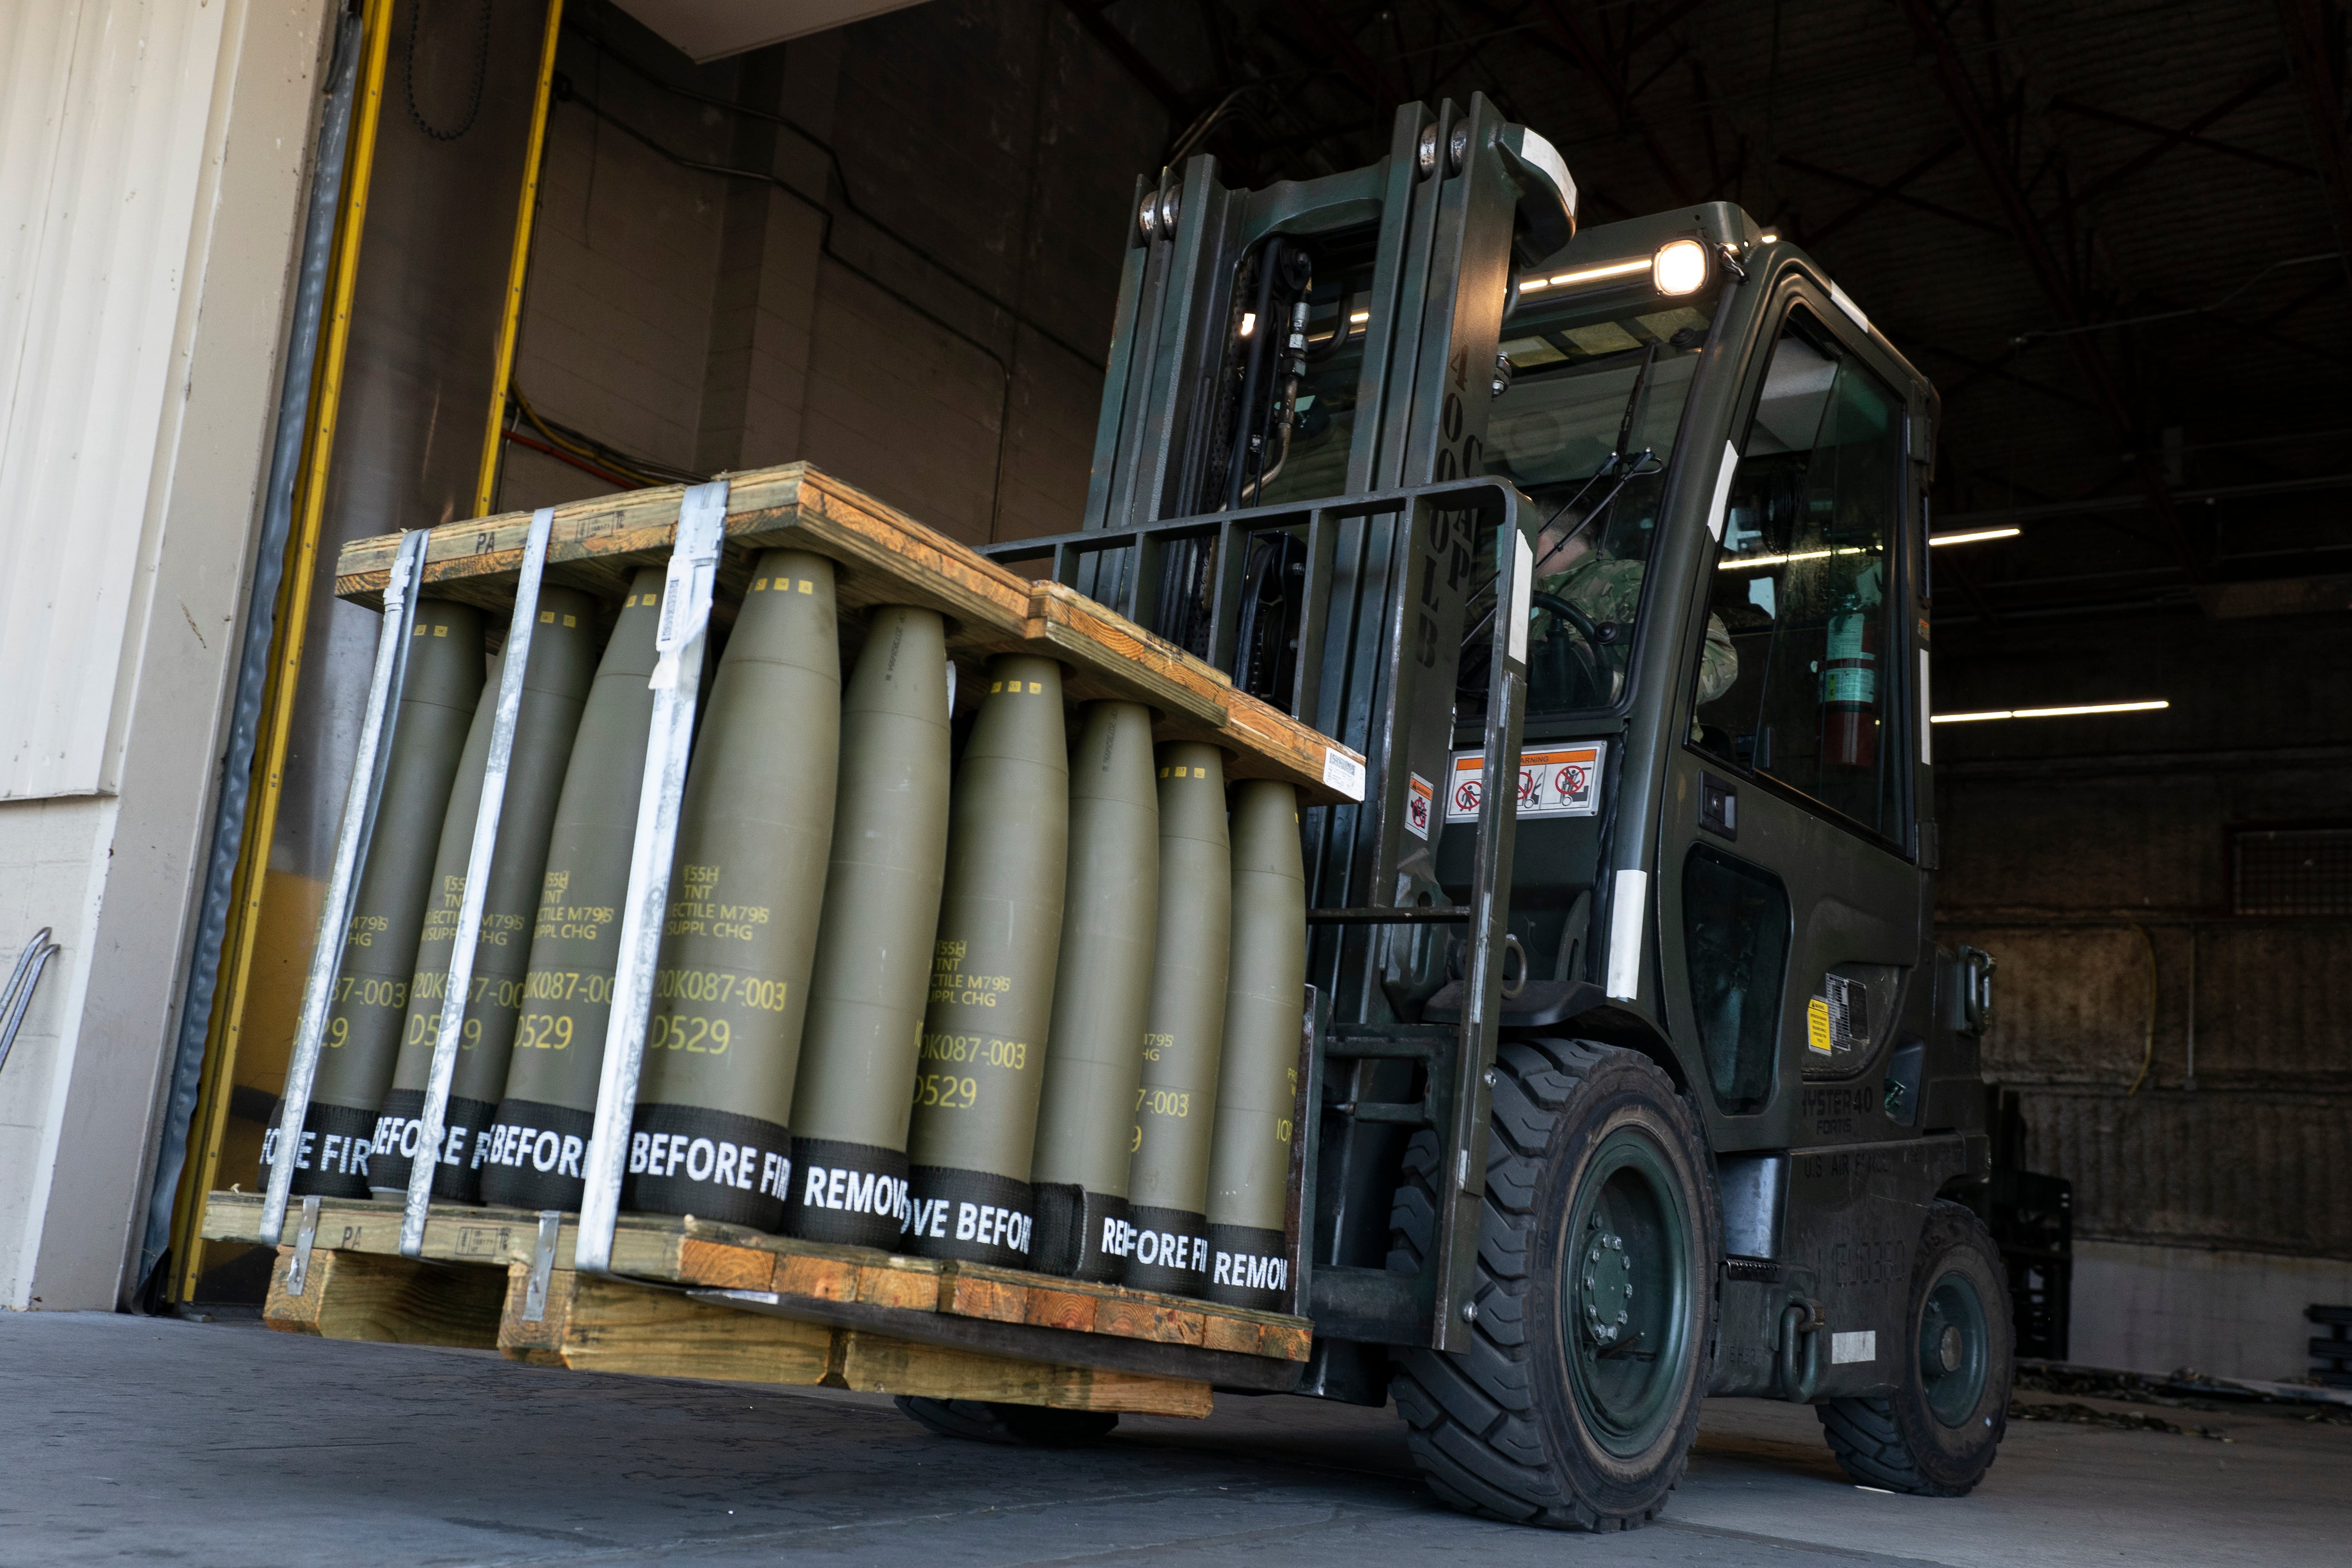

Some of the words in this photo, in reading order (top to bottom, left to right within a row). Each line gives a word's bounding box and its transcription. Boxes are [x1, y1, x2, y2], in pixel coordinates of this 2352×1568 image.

[475, 531, 495, 554] PA
[683, 884, 714, 899] TNT
[445, 894, 463, 907] TN
[567, 907, 614, 924] M795
[720, 905, 771, 924] M795
[561, 923, 597, 940] CHG
[712, 922, 753, 941] CHG
[936, 958, 961, 971] TNT
[967, 975, 1011, 992] M795
[961, 991, 997, 1007] CHG
[651, 1015, 731, 1055] D529
[629, 1132, 758, 1190] BEFORE
[1831, 1154, 1850, 1177] AIR
